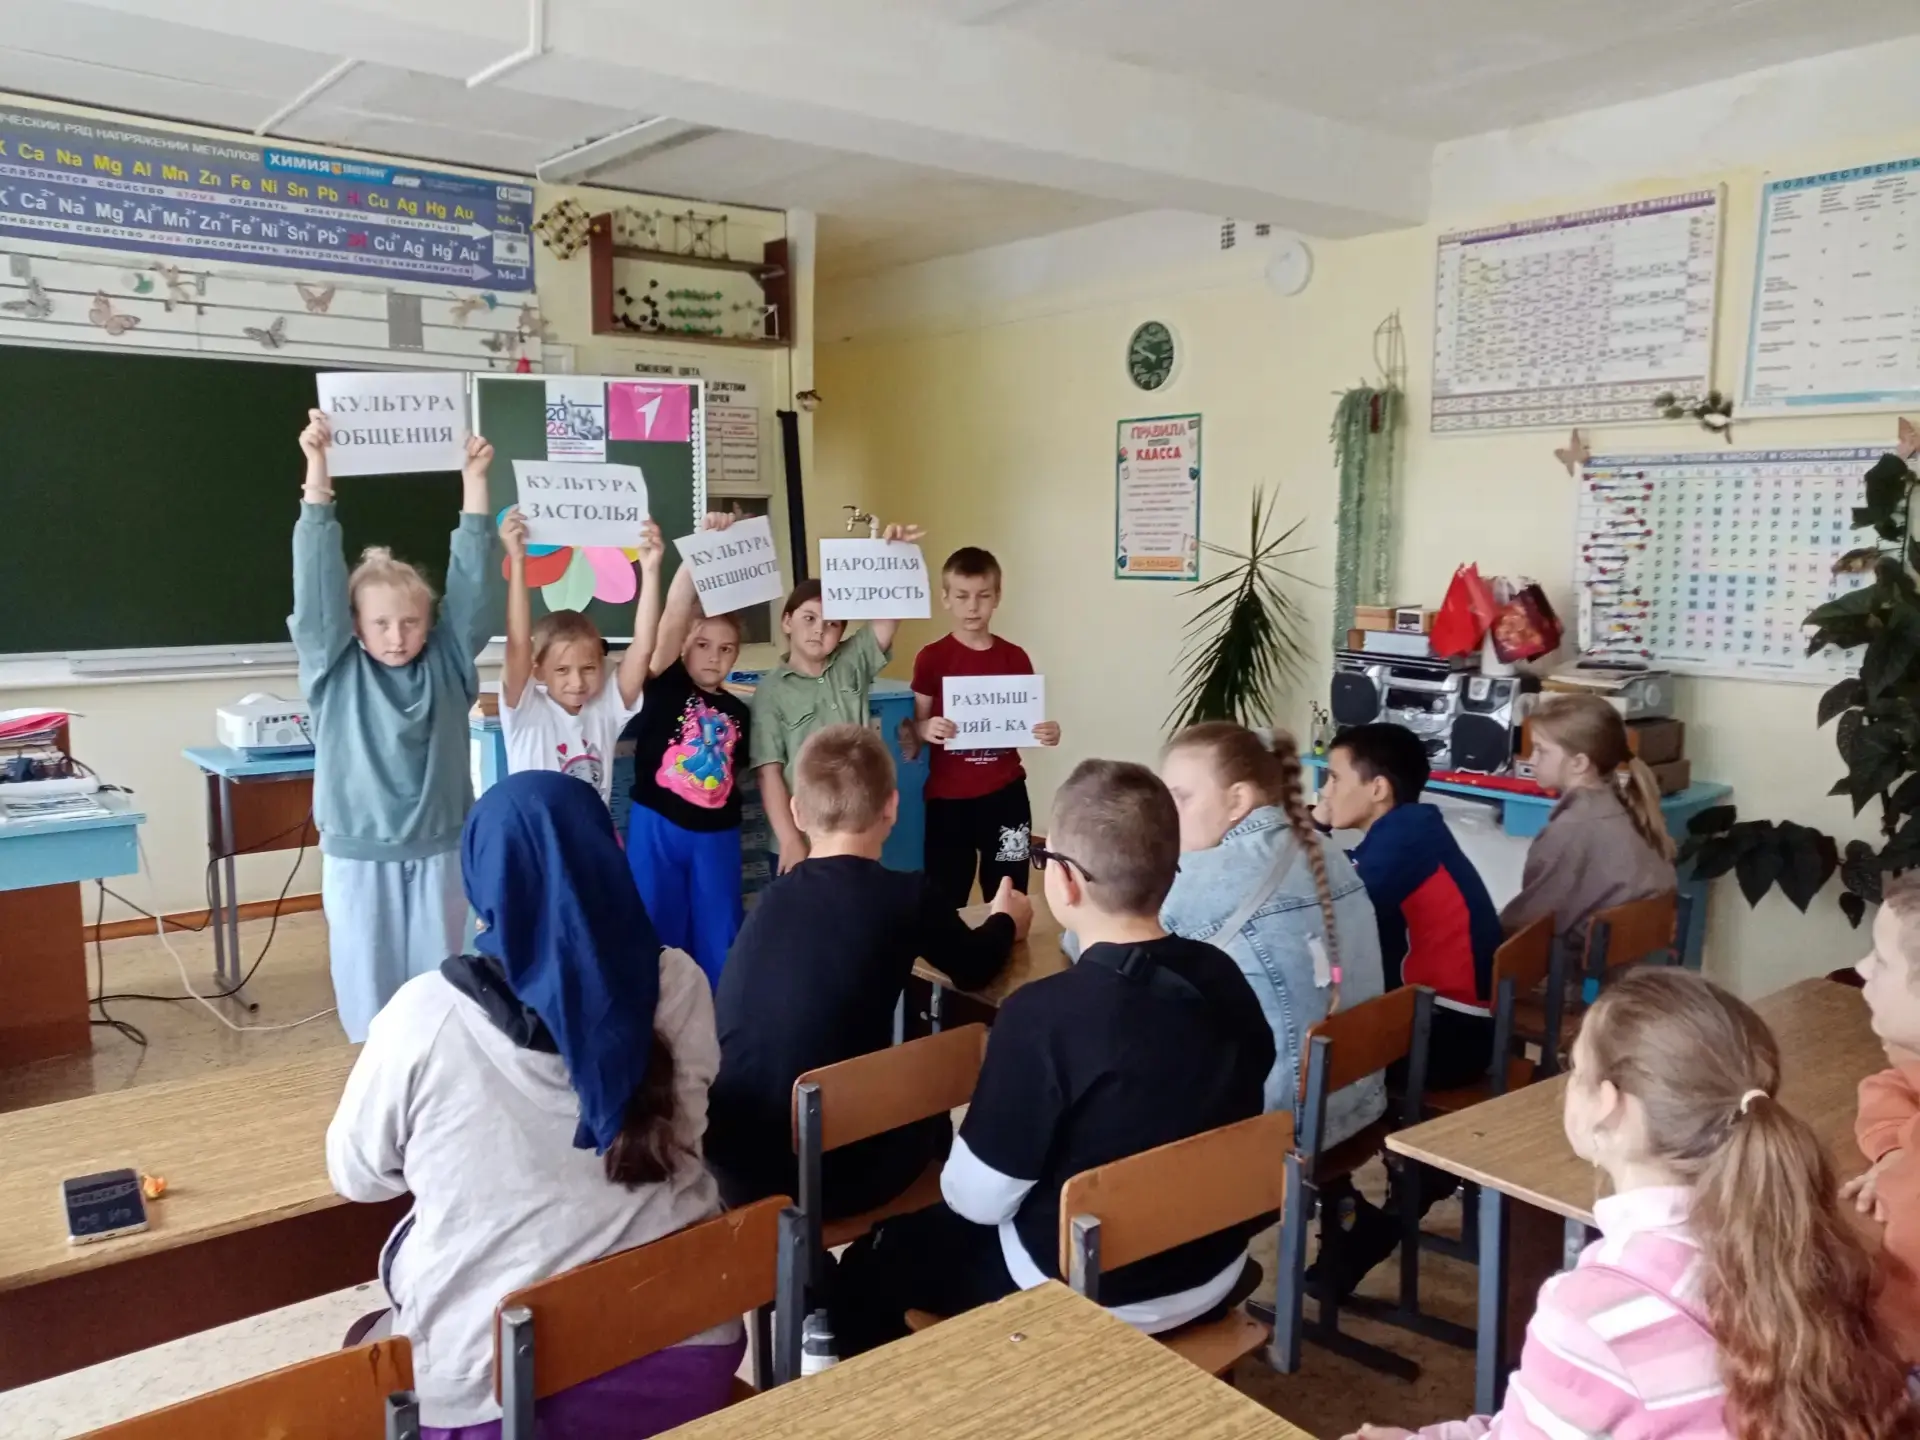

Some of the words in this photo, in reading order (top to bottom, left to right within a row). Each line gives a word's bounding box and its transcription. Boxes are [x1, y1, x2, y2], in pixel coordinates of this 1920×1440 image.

[64, 123, 93, 138] РЯД
[192, 143, 260, 161] МЕТАЛЛОВ
[269, 153, 330, 173] ХИМИЯ
[18, 142, 45, 161] Ca
[56, 148, 82, 167] Na
[93, 153, 122, 176] Mg
[132, 161, 152, 177] Al
[162, 164, 189, 182] Mn
[199, 169, 221, 186] Zn
[230, 173, 251, 191] Fe
[261, 178, 277, 194] Ni
[287, 182, 308, 198] Sn
[317, 186, 338, 202] Pb
[367, 193, 388, 209] Cu
[397, 197, 418, 215] Ag
[426, 201, 446, 219] Hg
[454, 205, 474, 219] Au
[229, 198, 288, 210] отдавать
[678, 367, 701, 376] ЦВЕТА
[331, 394, 456, 413] КУЛЬТУРА
[546, 407, 566, 421] 20
[333, 426, 454, 447] ОБЩЕНИЯ
[546, 423, 566, 436] 26
[1131, 423, 1186, 439] ПРАВИЛА
[1136, 446, 1182, 460] КЛАССА
[526, 474, 638, 494] КУЛЬТУРА
[528, 504, 639, 522] ЗАСТОЛЬЯ
[690, 537, 770, 566] КУЛЬТУРА
[826, 557, 920, 572] НАРОДНАЯ
[827, 585, 925, 602] МУДРОСТЬ
[951, 690, 1028, 707] РАЗМЫШ
[1005, 719, 1028, 732] КА
